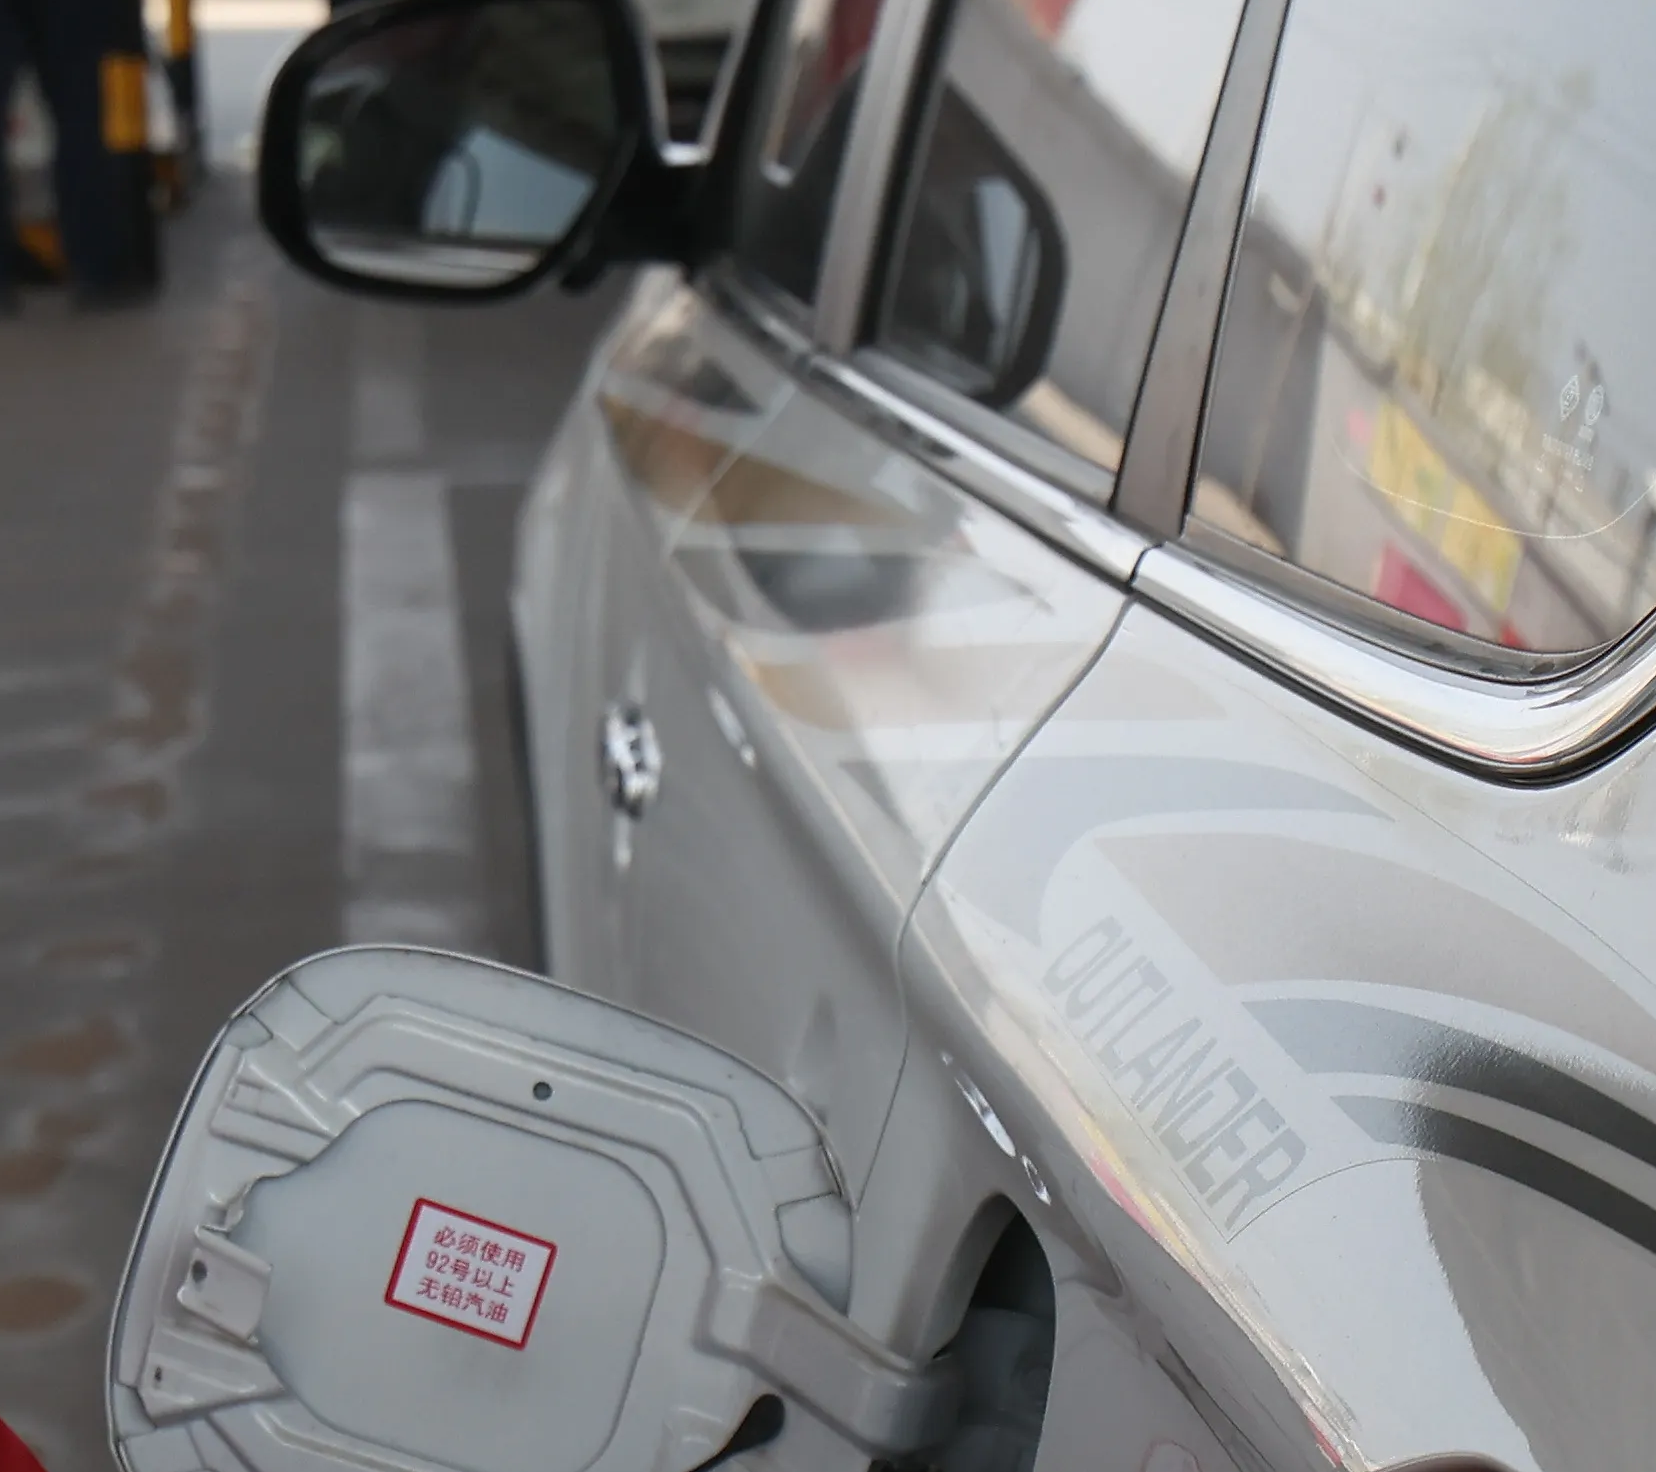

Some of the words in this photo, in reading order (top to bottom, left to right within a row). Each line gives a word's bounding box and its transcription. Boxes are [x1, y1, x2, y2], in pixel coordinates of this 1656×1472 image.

[1042, 914, 1307, 1232] OUTLANDER
[425, 1249, 515, 1298] 92号以上
[433, 1225, 526, 1274] 必须使用
[415, 1275, 510, 1324] 无铅汽油
